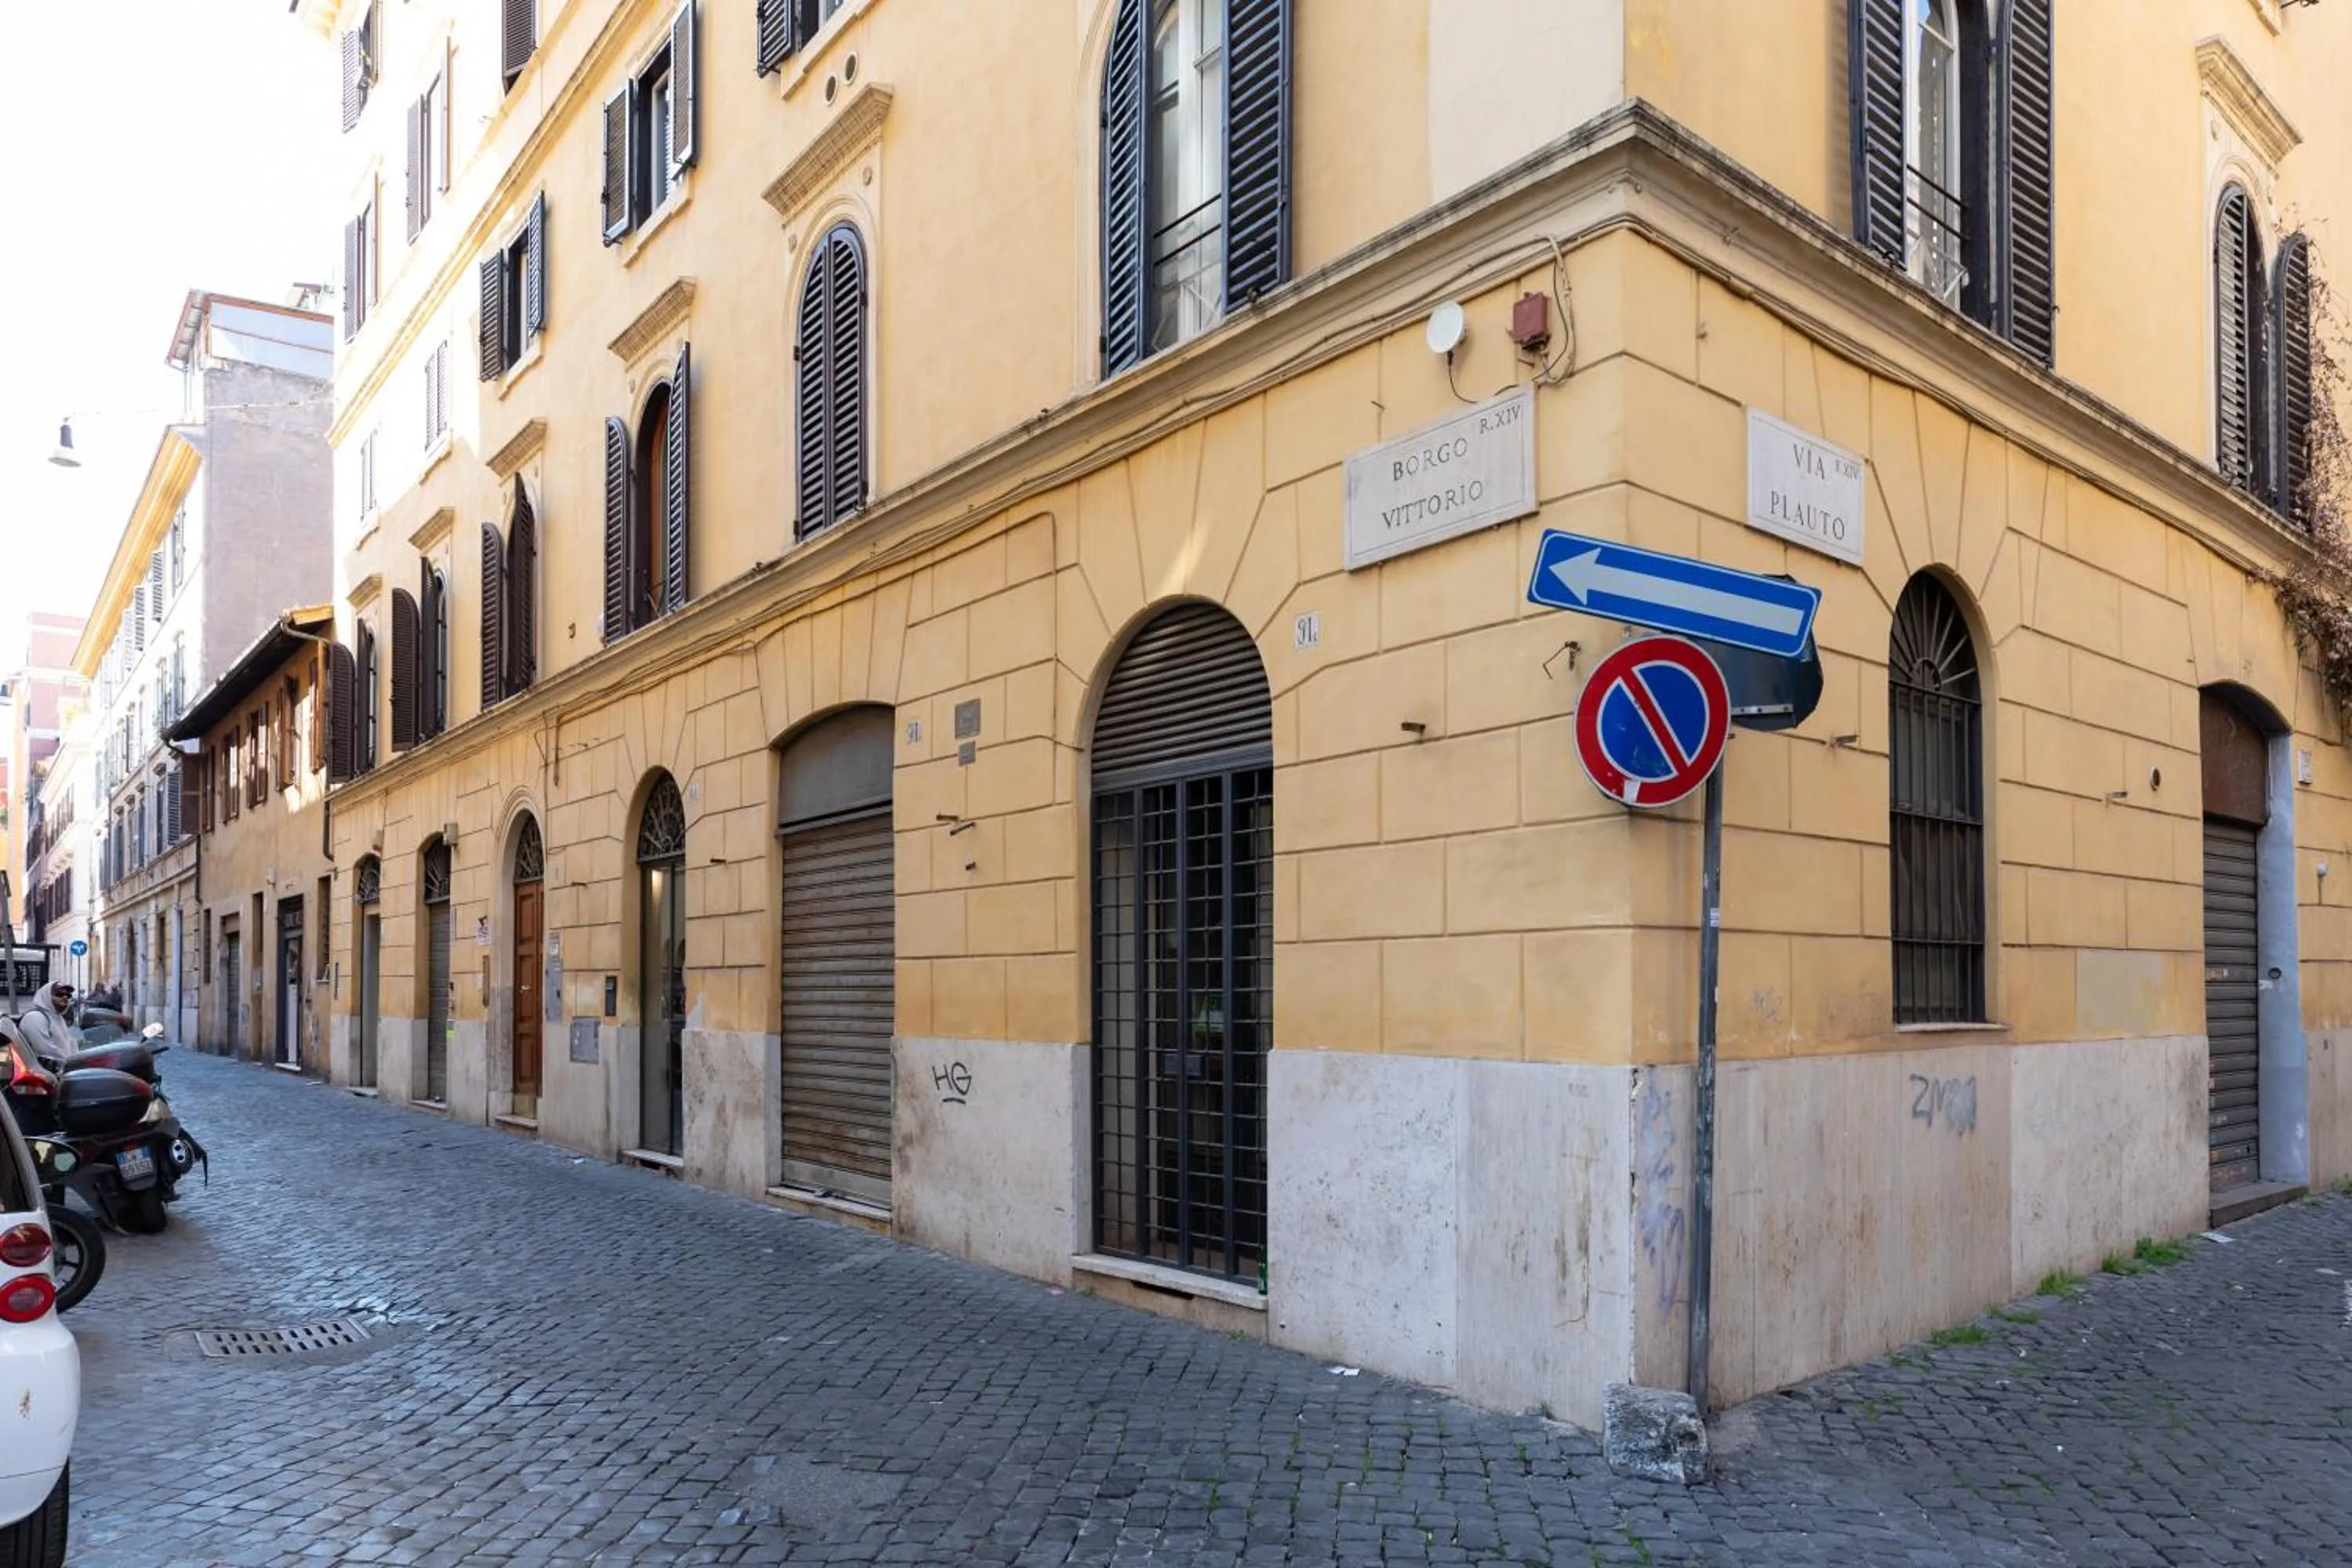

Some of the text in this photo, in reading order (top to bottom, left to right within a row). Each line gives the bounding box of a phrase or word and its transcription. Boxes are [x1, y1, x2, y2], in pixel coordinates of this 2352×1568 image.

[1392, 437, 1468, 481] BORGO
[1793, 443, 1826, 480] VIA
[1381, 480, 1484, 529] VITTORIO
[1770, 490, 1846, 541] PLAUTO
[932, 1061, 972, 1096] HG
